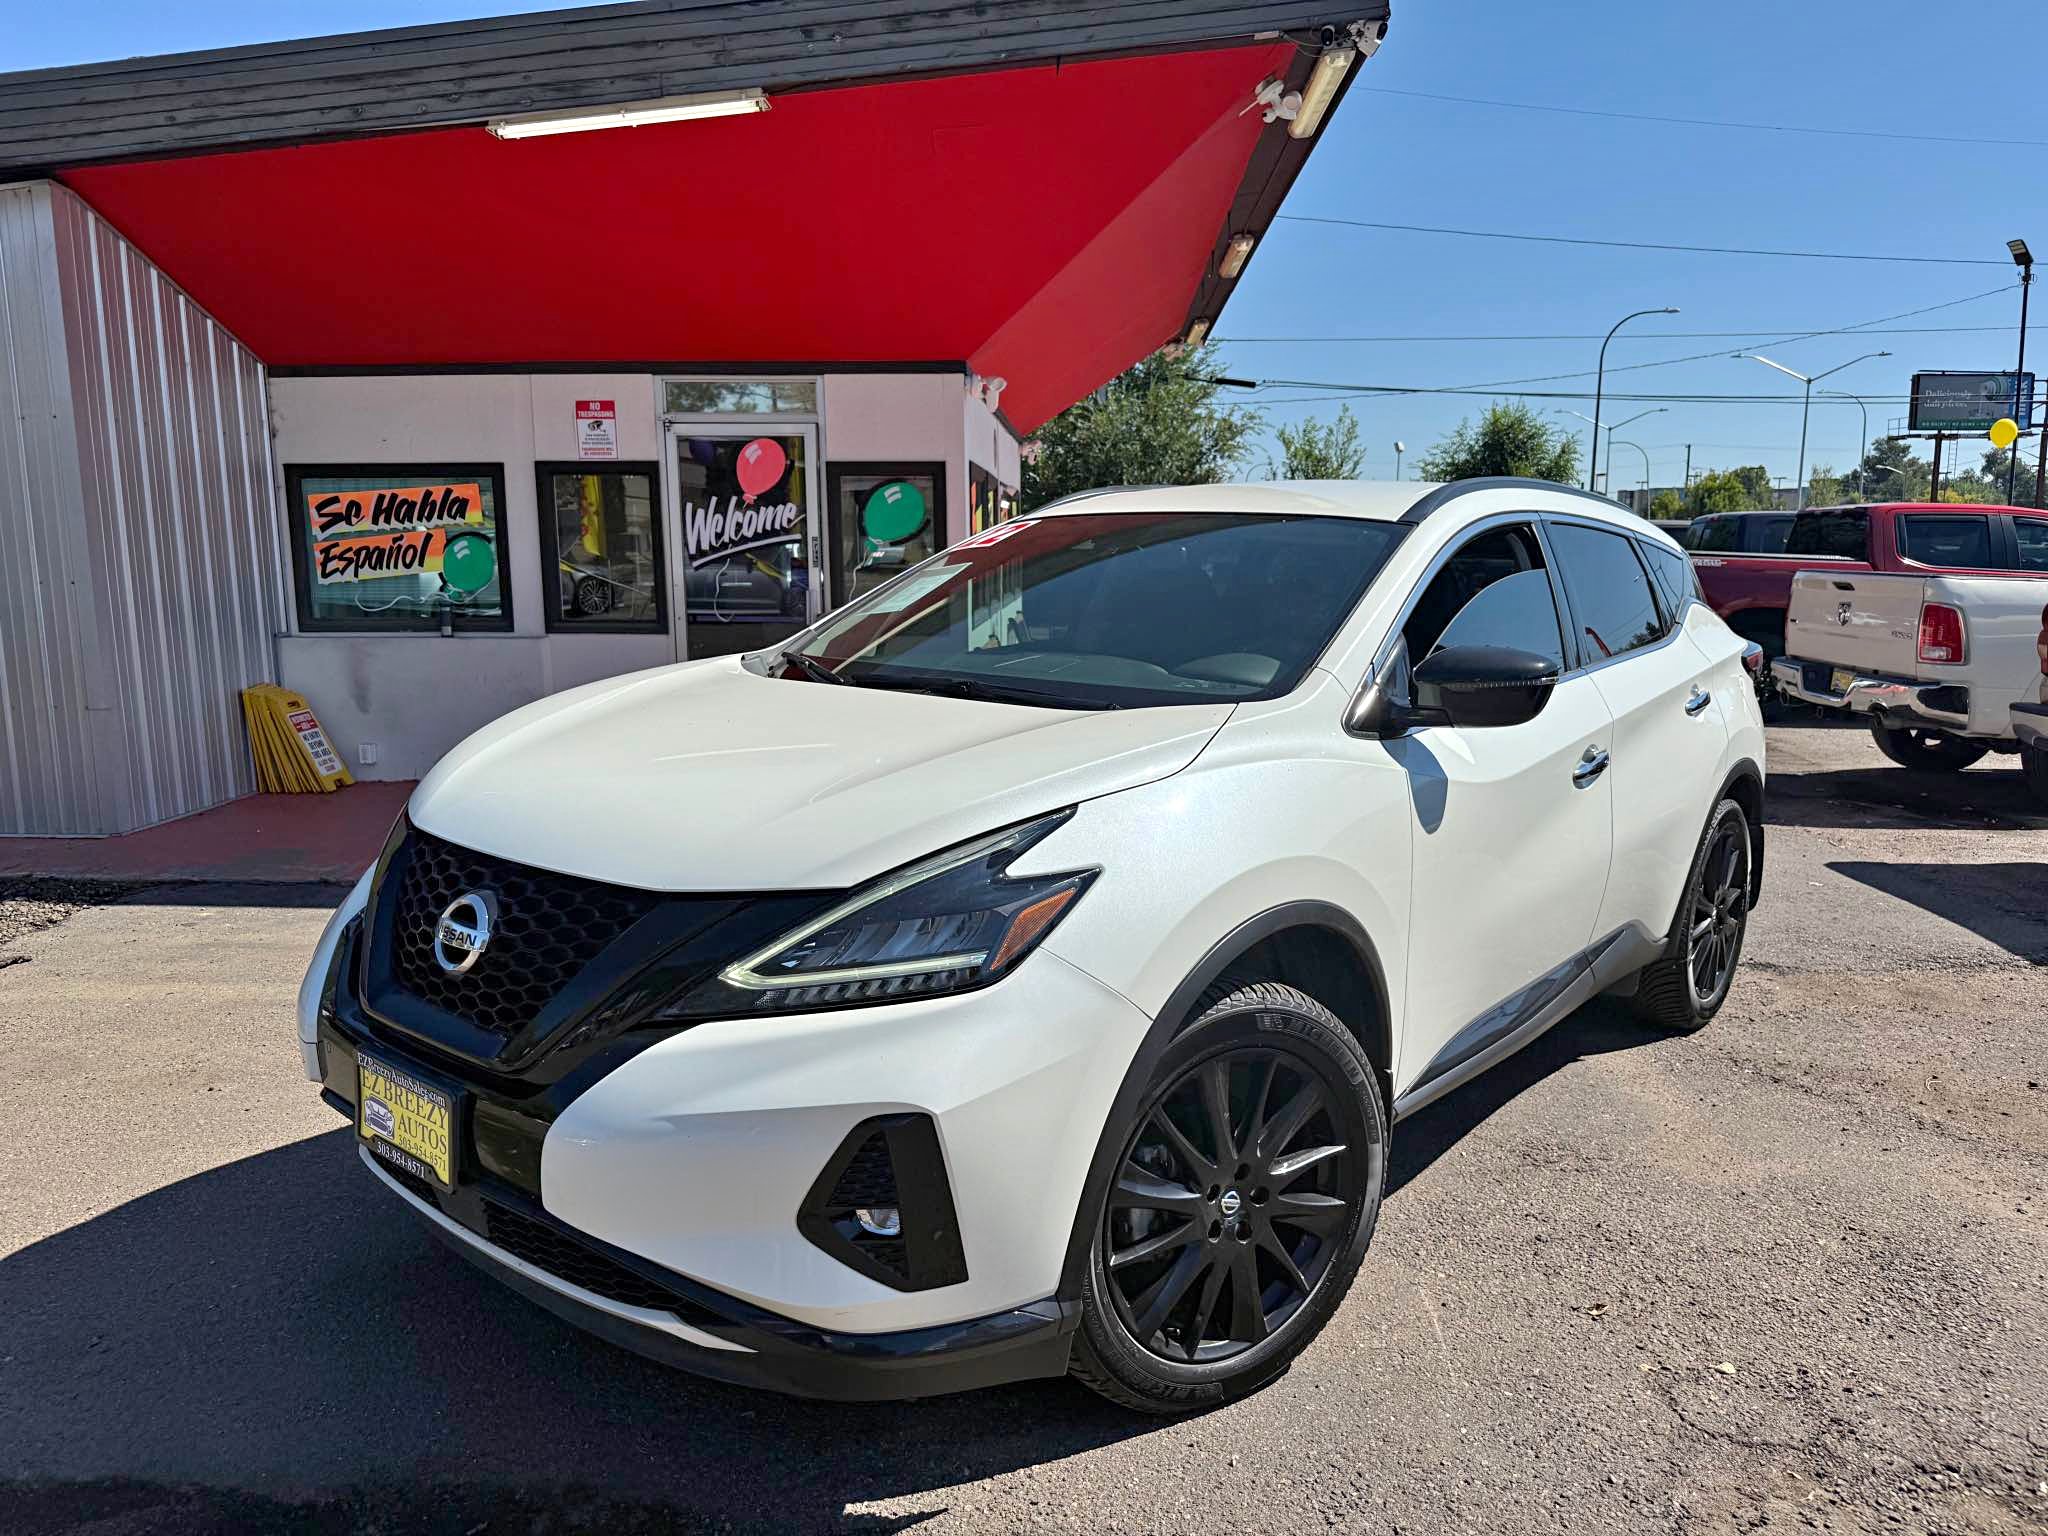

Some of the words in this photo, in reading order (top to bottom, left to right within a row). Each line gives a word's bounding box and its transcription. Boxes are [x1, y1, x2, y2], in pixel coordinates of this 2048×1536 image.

[589, 402, 601, 410] NO
[314, 495, 365, 533] Se
[371, 487, 470, 526] Habla
[685, 495, 804, 555] Welcome
[319, 532, 433, 578] Español
[397, 1113, 448, 1156] AUTOS
[398, 1134, 447, 1172] 303-954-8571
[377, 1141, 426, 1179] 303-954-8571
